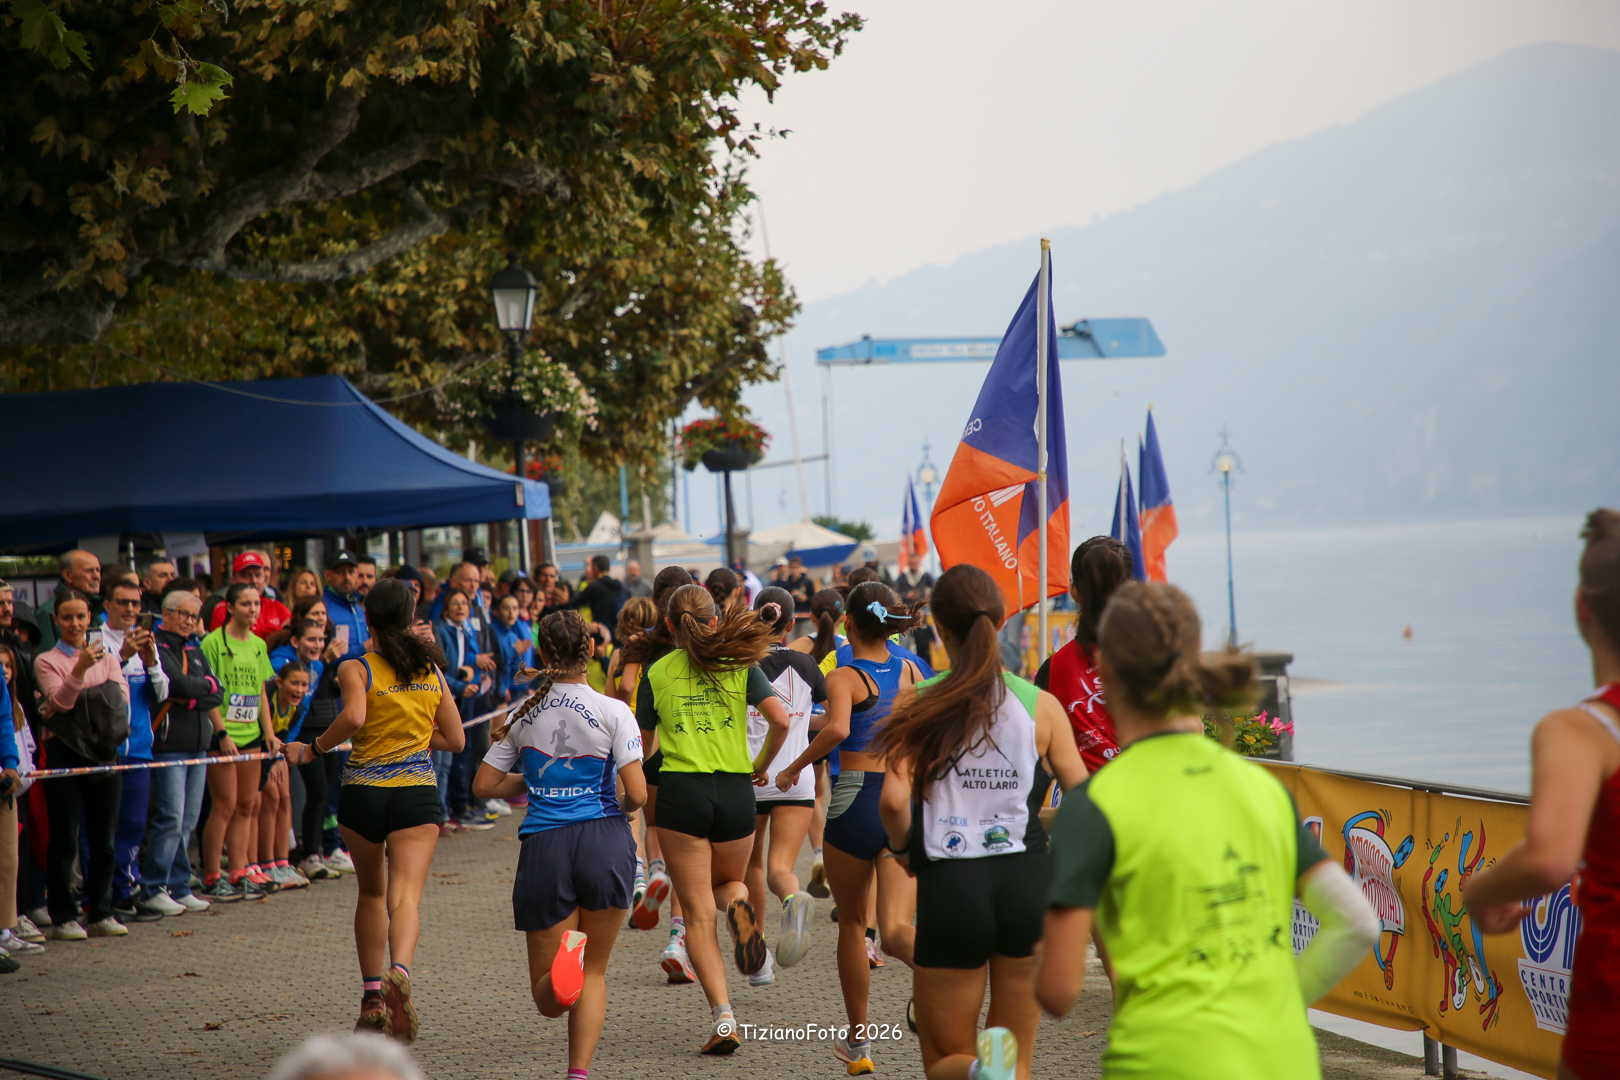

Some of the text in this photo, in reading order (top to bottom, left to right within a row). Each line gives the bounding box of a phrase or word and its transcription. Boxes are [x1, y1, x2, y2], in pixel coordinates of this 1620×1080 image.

[980, 510, 1018, 569] ITALIANO
[388, 683, 439, 693] CORTENOVA
[234, 708, 254, 720] 540
[520, 692, 600, 730] Valchiese
[964, 768, 1019, 778] ATLETICA
[962, 780, 1019, 790] ALTO LARIO
[529, 786, 595, 798] ATLETICA
[1525, 986, 1570, 1012] SPORTIV
[1532, 1002, 1569, 1025] ITALIA
